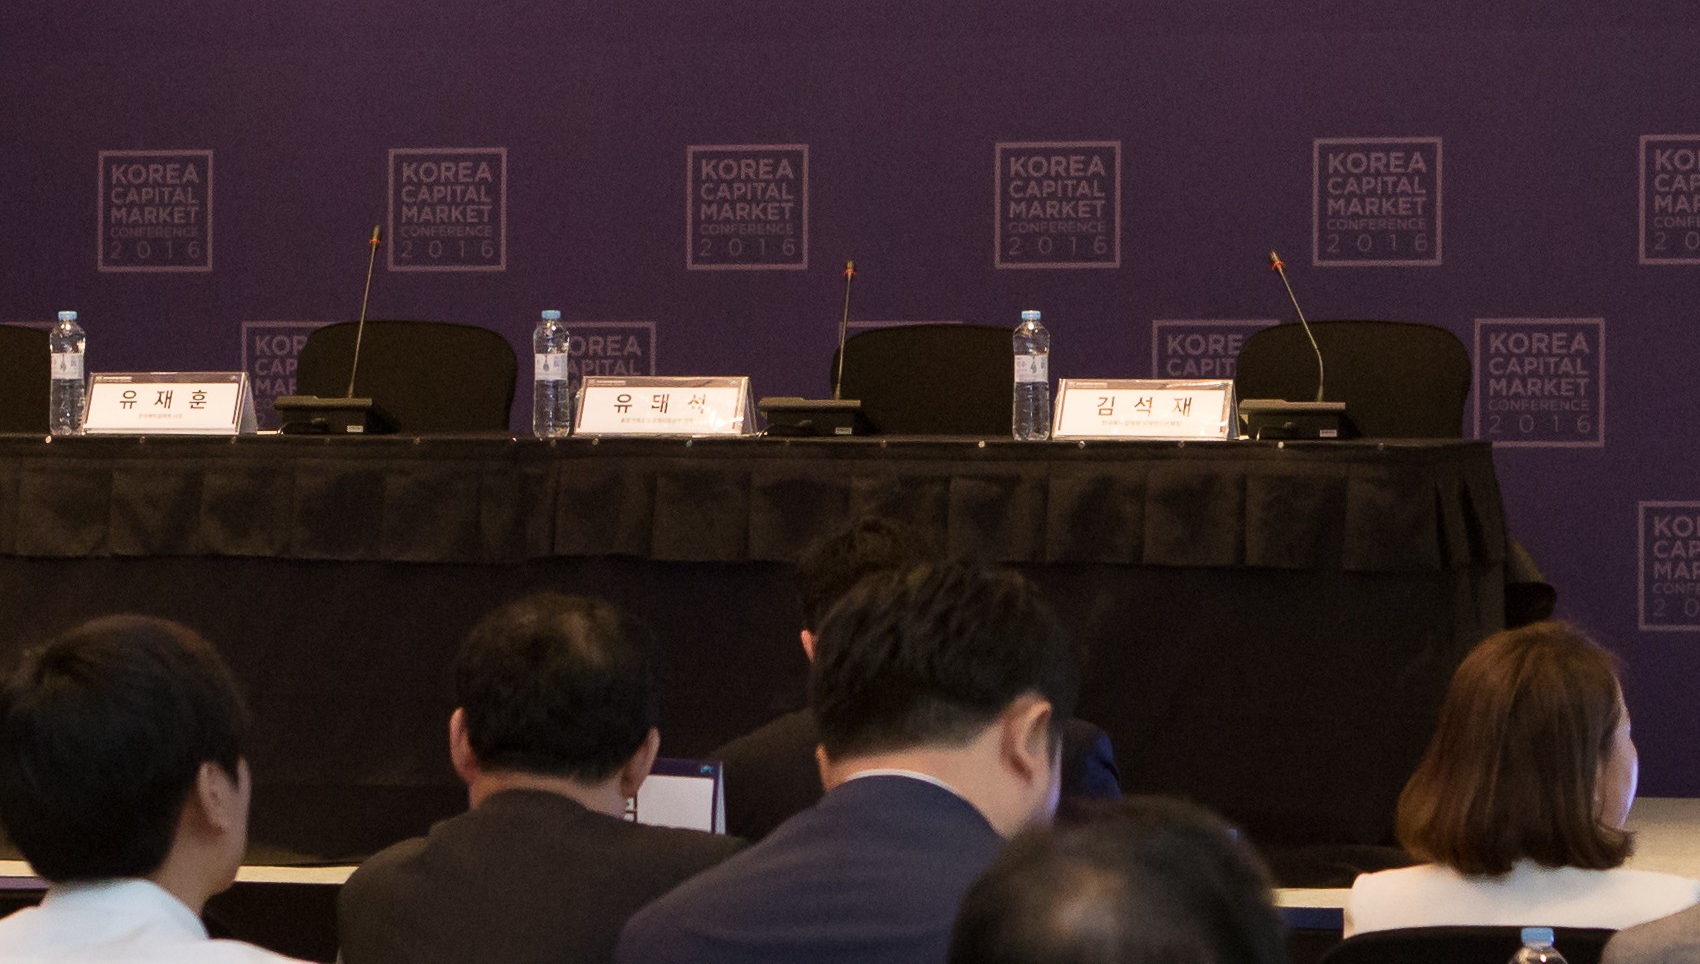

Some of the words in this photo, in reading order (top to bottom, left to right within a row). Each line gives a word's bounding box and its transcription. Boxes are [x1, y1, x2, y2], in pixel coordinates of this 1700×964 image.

[402, 161, 493, 183] KOREA
[701, 158, 794, 180] KOREA
[1009, 155, 1106, 177] KOREA
[1328, 151, 1427, 174] KOREA
[111, 163, 199, 185] KOREA
[111, 186, 200, 204] CAPITAL
[400, 184, 492, 204] CAPITAL
[700, 182, 794, 200] CAPITAL
[1009, 179, 1106, 198] CAPITAL
[1327, 176, 1427, 195] CAPITAL
[110, 206, 199, 224] MARKET
[401, 205, 493, 223] MARKET
[700, 203, 794, 221] MARKET
[1009, 200, 1106, 219] MARKET
[1327, 197, 1427, 216] MARKET
[255, 335, 308, 356] KOR
[568, 335, 641, 356] OREA
[1167, 334, 1243, 356] KORE
[1489, 332, 1590, 354] KOREA
[567, 358, 640, 376] APITAL
[1166, 358, 1236, 377] CAPIT
[1488, 356, 1589, 375] CAPITAL
[1488, 377, 1590, 397] MARKET
